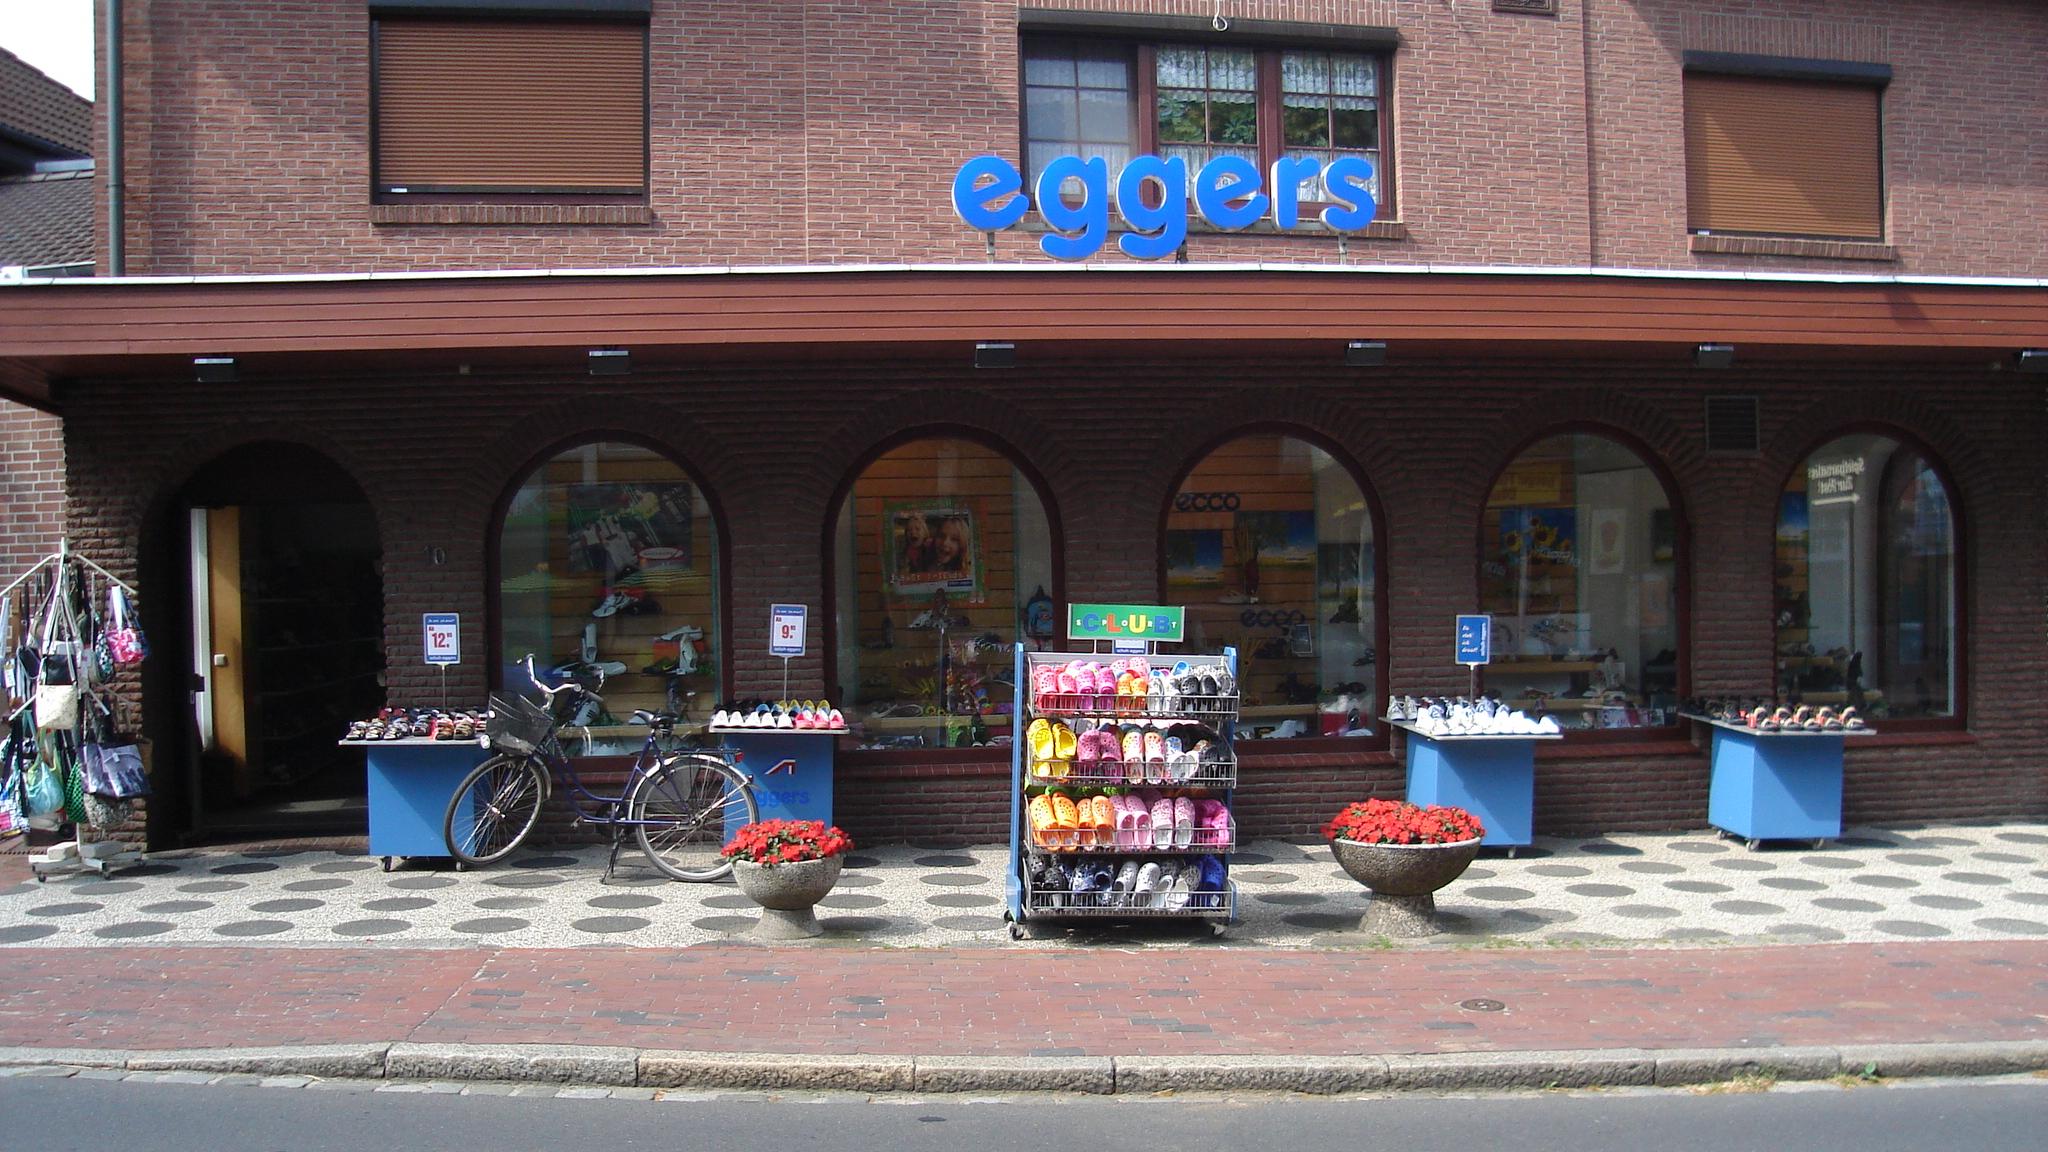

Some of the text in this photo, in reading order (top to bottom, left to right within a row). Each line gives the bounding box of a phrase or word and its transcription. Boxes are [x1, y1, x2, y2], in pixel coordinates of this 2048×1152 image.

[951, 155, 1377, 261] eggers
[1175, 492, 1240, 512] ecco
[1082, 613, 1170, 634] CLUB
[756, 790, 809, 808] ggers
